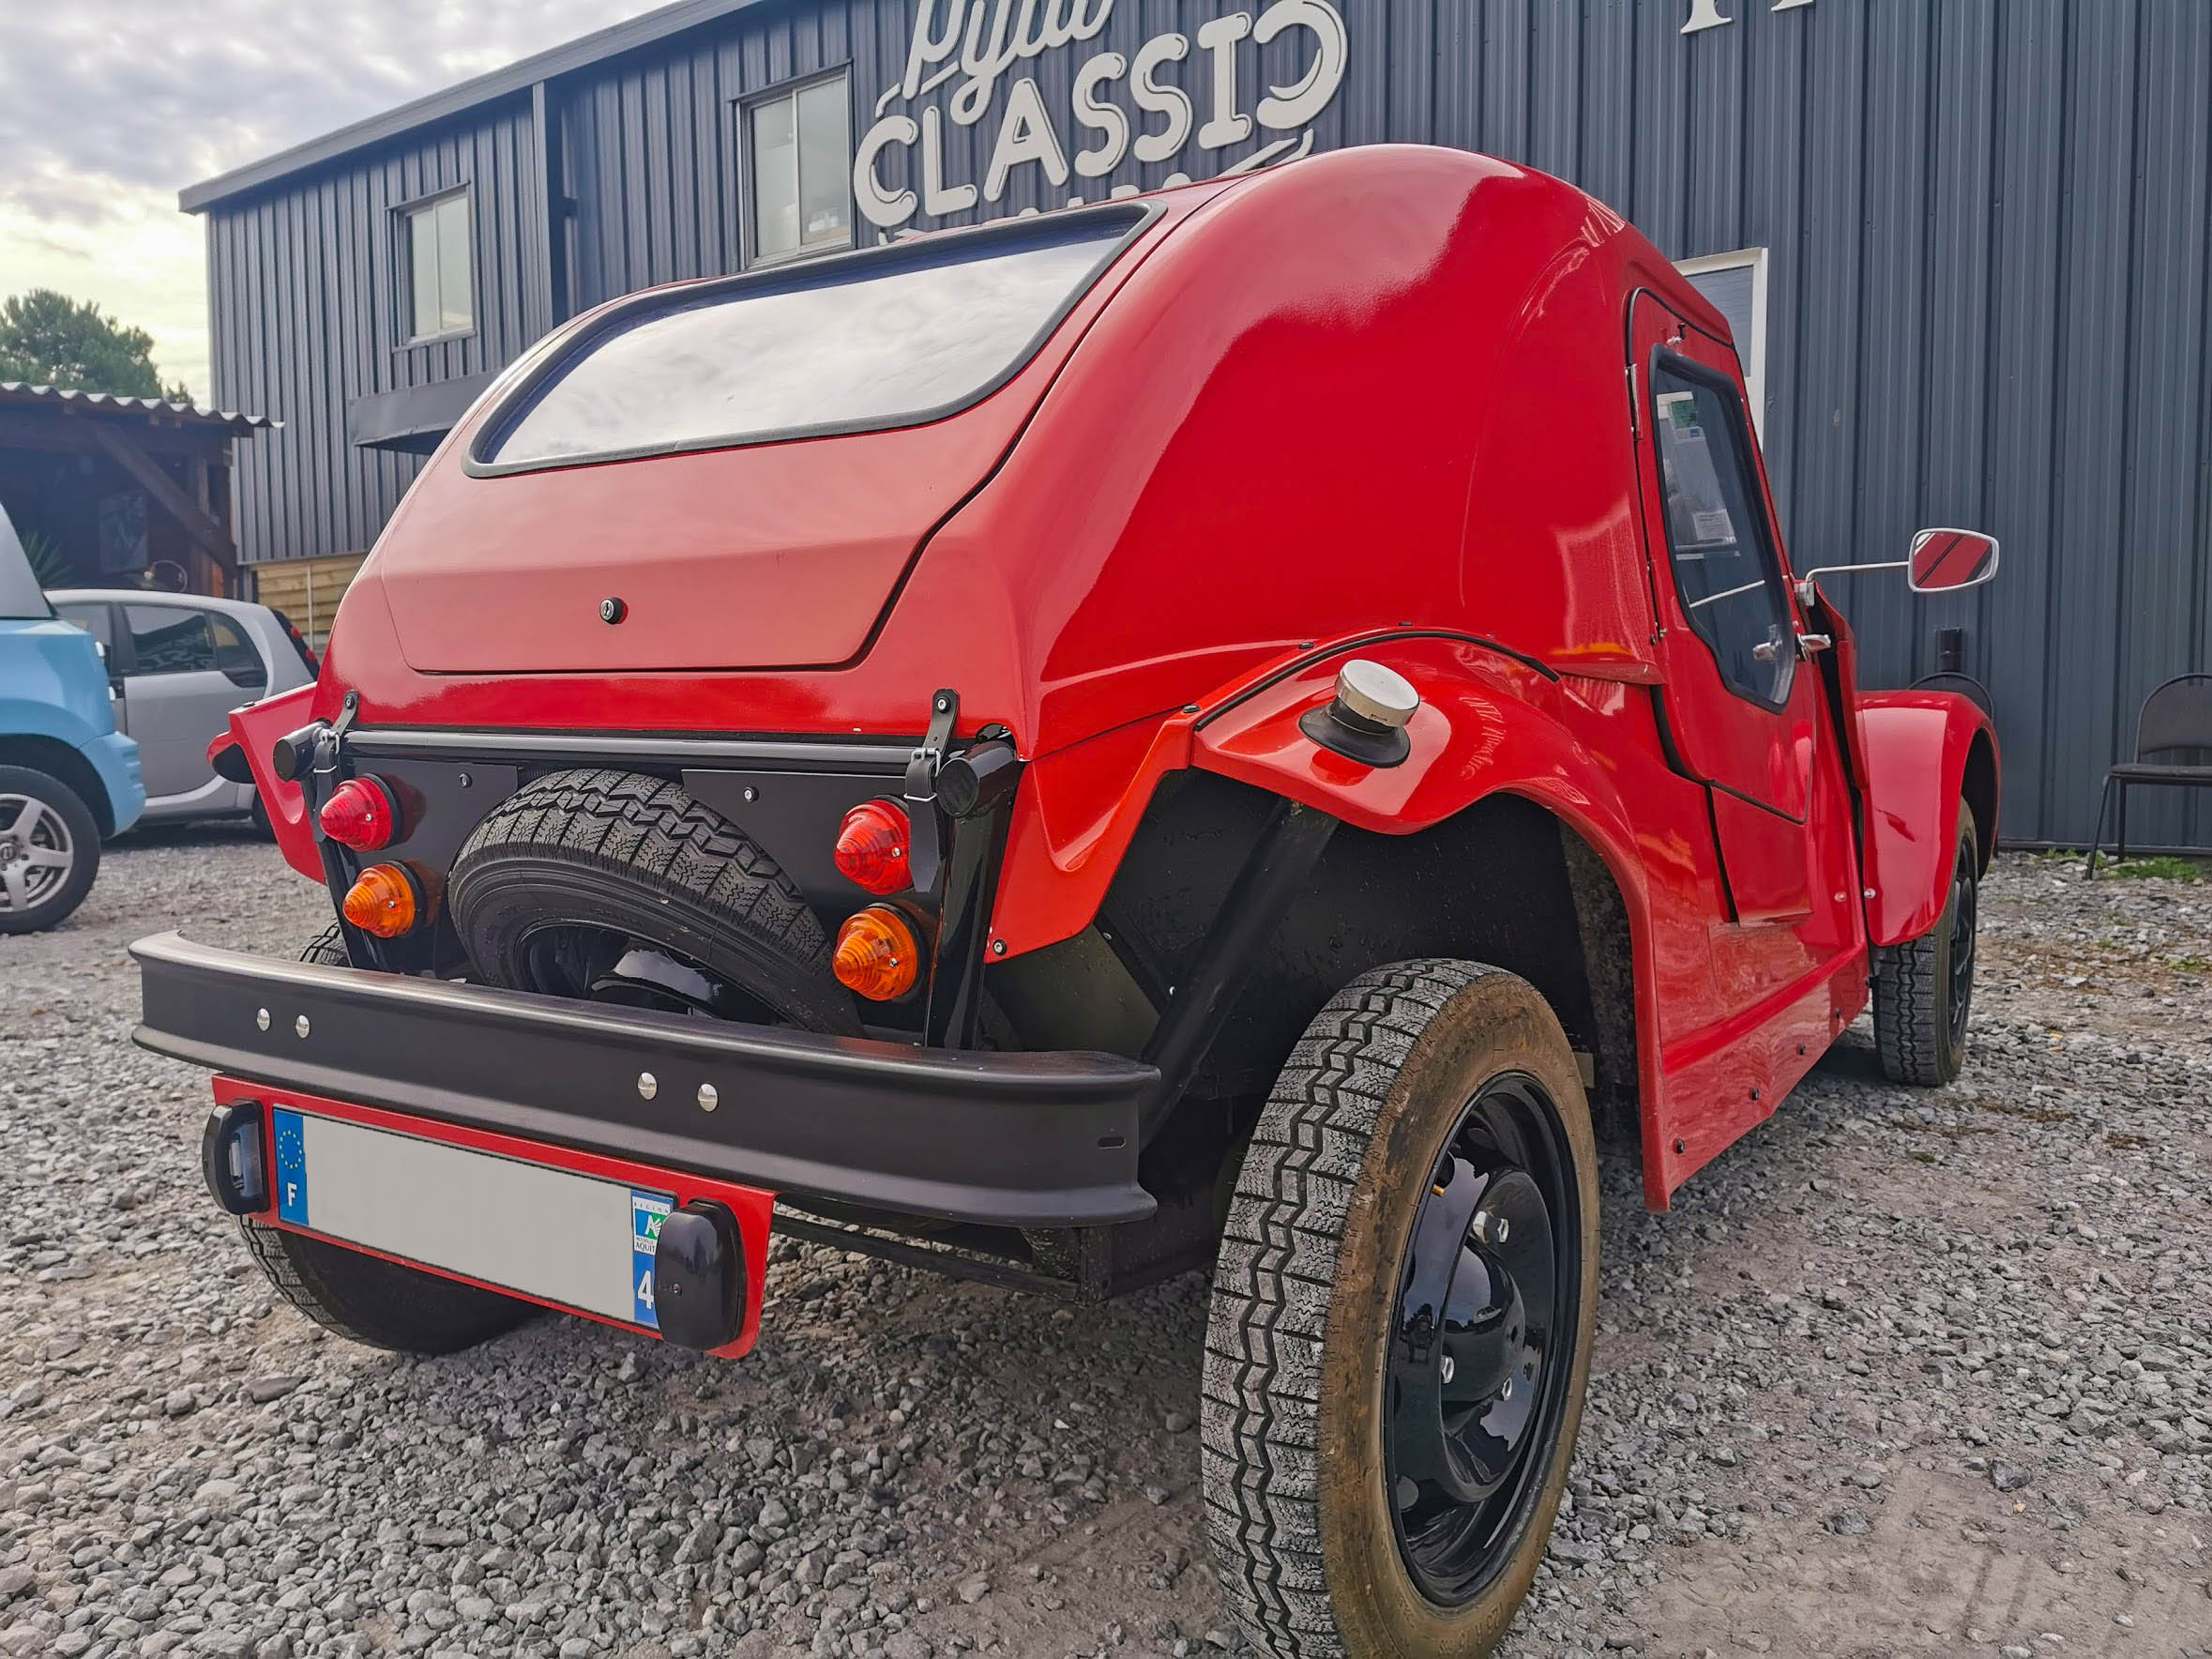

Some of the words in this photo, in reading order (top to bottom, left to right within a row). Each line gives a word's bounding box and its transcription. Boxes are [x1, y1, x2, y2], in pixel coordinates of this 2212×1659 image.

[852, 0, 1349, 227] CLASSIC
[287, 1182, 297, 1207] F
[635, 1240, 656, 1253] AQUIT
[637, 1270, 655, 1310] 4
